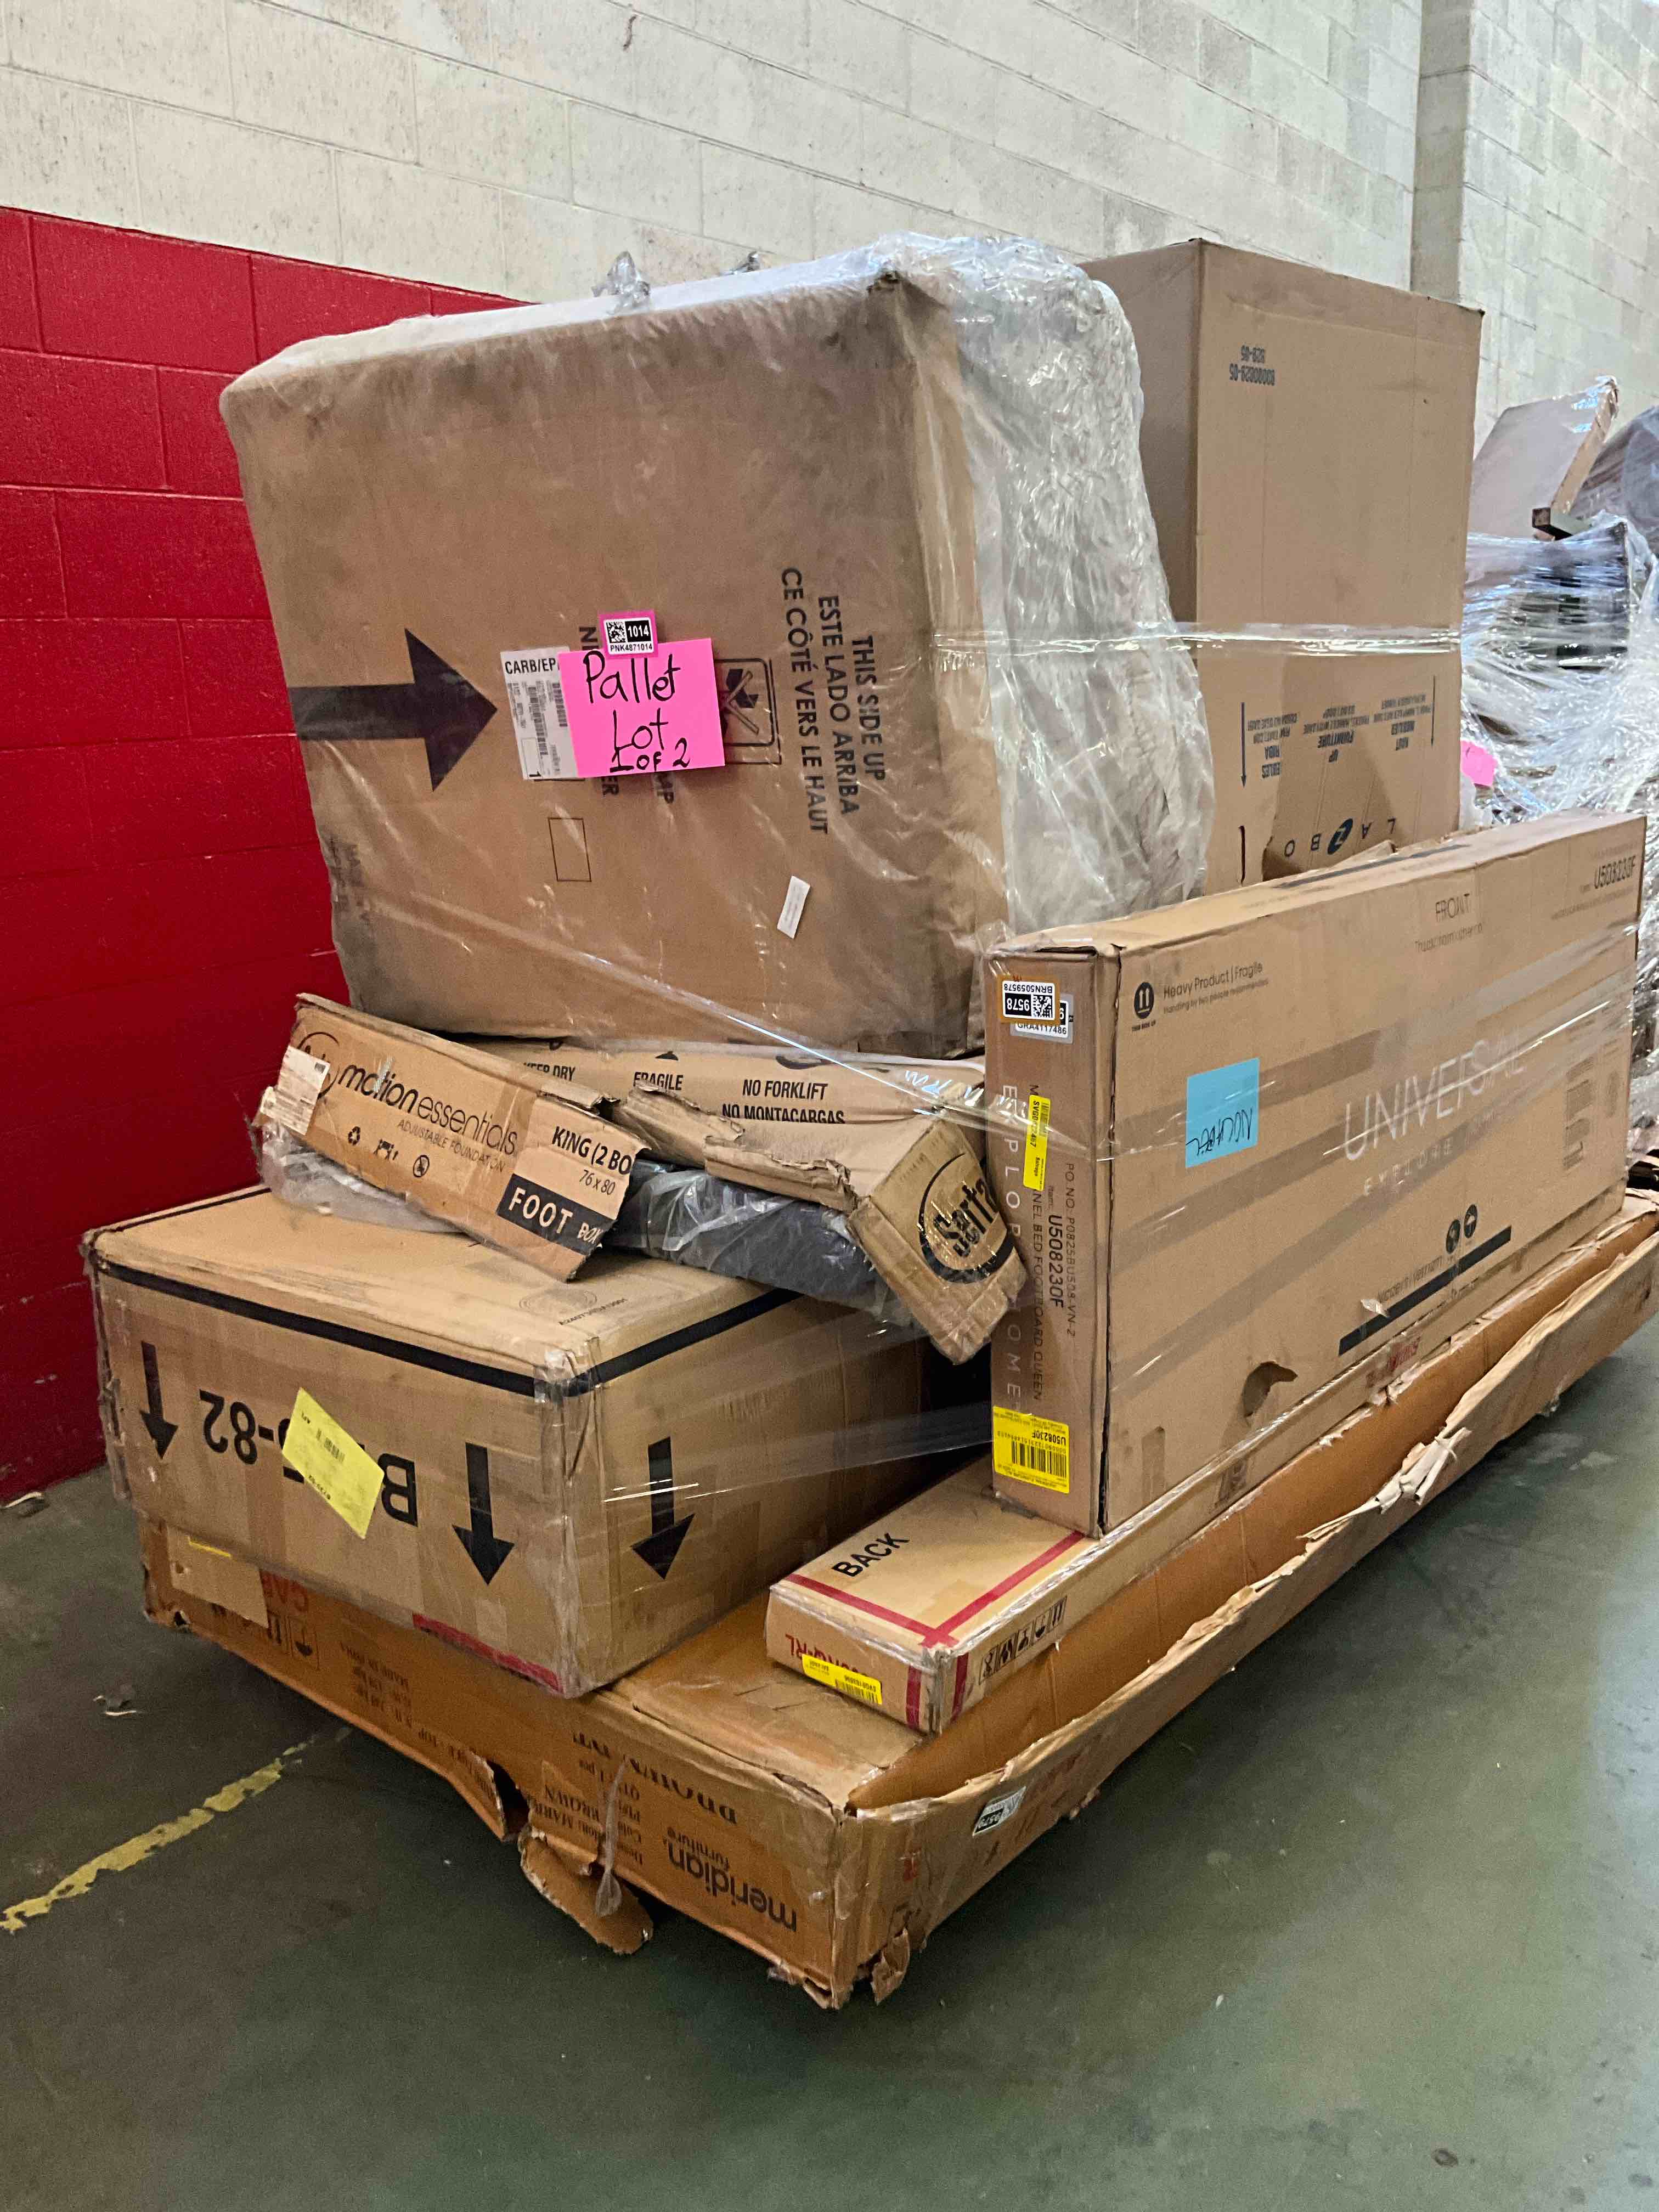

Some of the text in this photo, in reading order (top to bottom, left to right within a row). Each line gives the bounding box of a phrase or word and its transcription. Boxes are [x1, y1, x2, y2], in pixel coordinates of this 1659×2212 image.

[610, 644, 653, 652] PNK4871014
[628, 625, 650, 638] 1014
[505, 658, 558, 675] CARB/EP
[583, 650, 681, 704] Pallet
[781, 568, 829, 834] CE CÔTÉ VERS LE HAUT
[819, 595, 860, 815] ESTE LADO ARRIBA
[852, 635, 885, 782] THIS SIDE UP
[613, 708, 669, 751] Lot
[673, 737, 690, 768] 2
[1004, 984, 1053, 993] BRN5059578
[1164, 984, 1193, 999] Heavy
[1194, 970, 1229, 990] Product
[1235, 961, 1262, 979] Fragile
[1007, 997, 1030, 1012] 9578
[552, 1065, 576, 1082] DRY
[742, 1079, 829, 1101] NO FORKLIFT
[721, 1103, 741, 1119] NO
[397, 1119, 449, 1149] ADJUSTABLE
[551, 1126, 633, 1175] KING (2 BO
[579, 1169, 593, 1187] 76
[601, 1179, 616, 1195] 80
[508, 1186, 574, 1234] FOOT
[1032, 1224, 1042, 1251] BED
[1048, 1215, 1064, 1308] U508230F
[1034, 1352, 1044, 1401] QUEEN
[1031, 1430, 1066, 1446] U508230F
[831, 1532, 911, 1578] BACK
[667, 1826, 729, 1869] furniture
[667, 1838, 797, 1933] meridian
